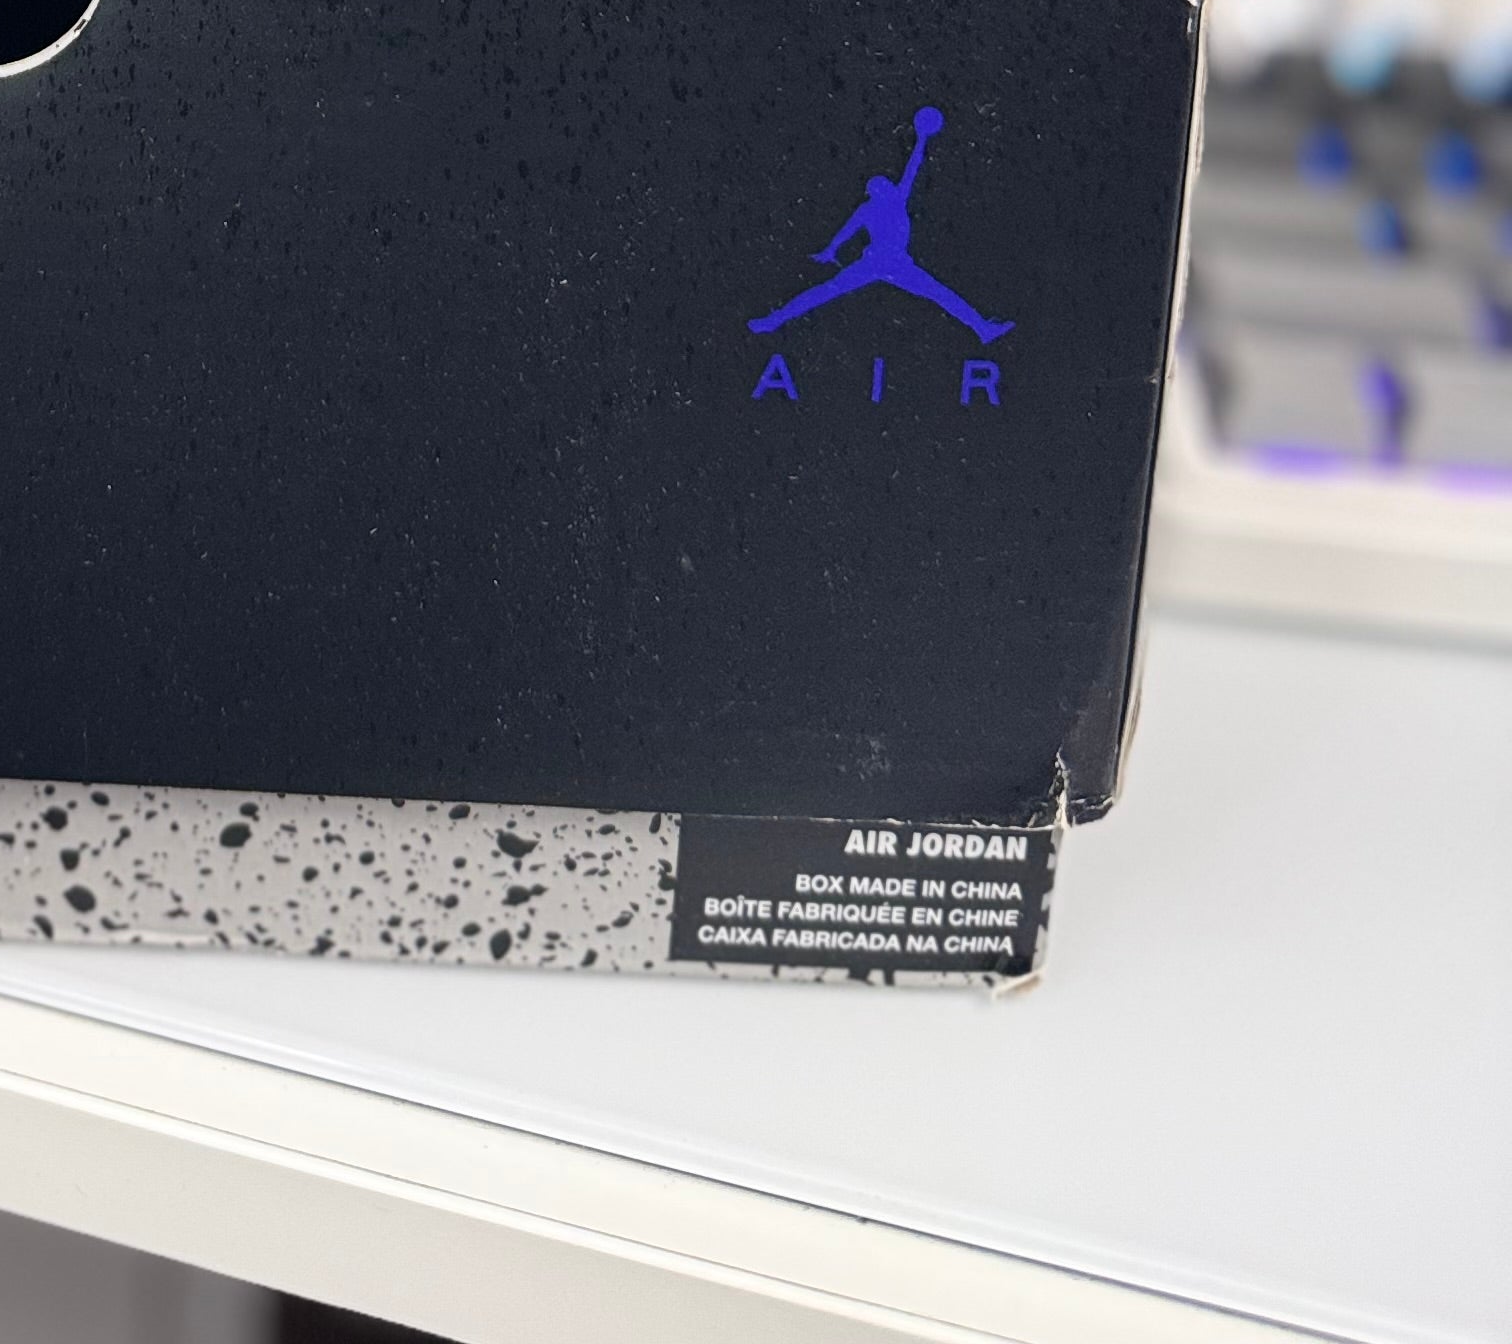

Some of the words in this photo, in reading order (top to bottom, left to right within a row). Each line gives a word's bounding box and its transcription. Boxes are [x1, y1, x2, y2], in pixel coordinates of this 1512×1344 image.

[751, 353, 1000, 406] AIR
[844, 829, 897, 857] AIR
[906, 832, 1027, 861] JORDAN
[795, 874, 843, 894] BOX
[849, 877, 916, 897] MADE
[921, 880, 945, 898] IN
[951, 881, 1022, 901] CHINA
[704, 895, 772, 918] BOÎTE
[778, 902, 905, 925] FABRIQUÉE
[912, 908, 942, 926] EN
[948, 909, 1018, 927] CHINE
[698, 925, 767, 946] CAIXA
[772, 929, 900, 950] FABRICADA
[906, 934, 938, 952] NA
[943, 935, 1013, 955] CHINA
